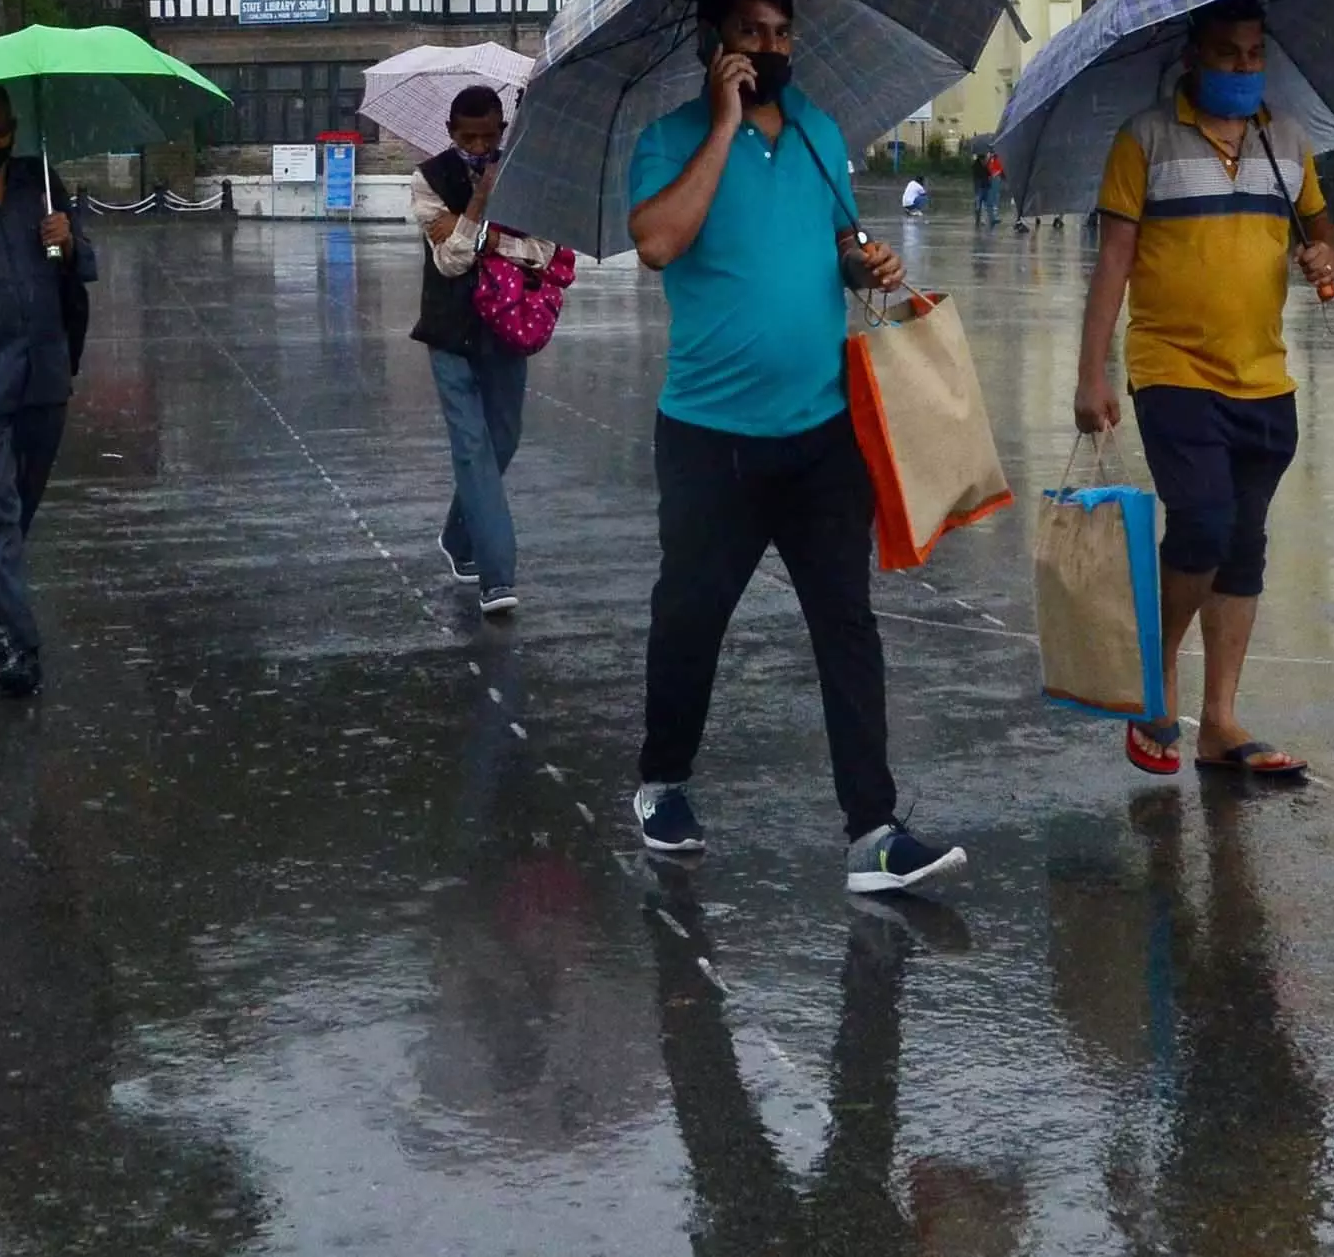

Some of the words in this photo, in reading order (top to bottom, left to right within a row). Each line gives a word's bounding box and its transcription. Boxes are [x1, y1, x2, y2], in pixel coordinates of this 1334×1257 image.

[242, 2, 261, 13] STATE
[265, 0, 296, 12] LIBRARY
[298, 0, 326, 11] SHIMLA
